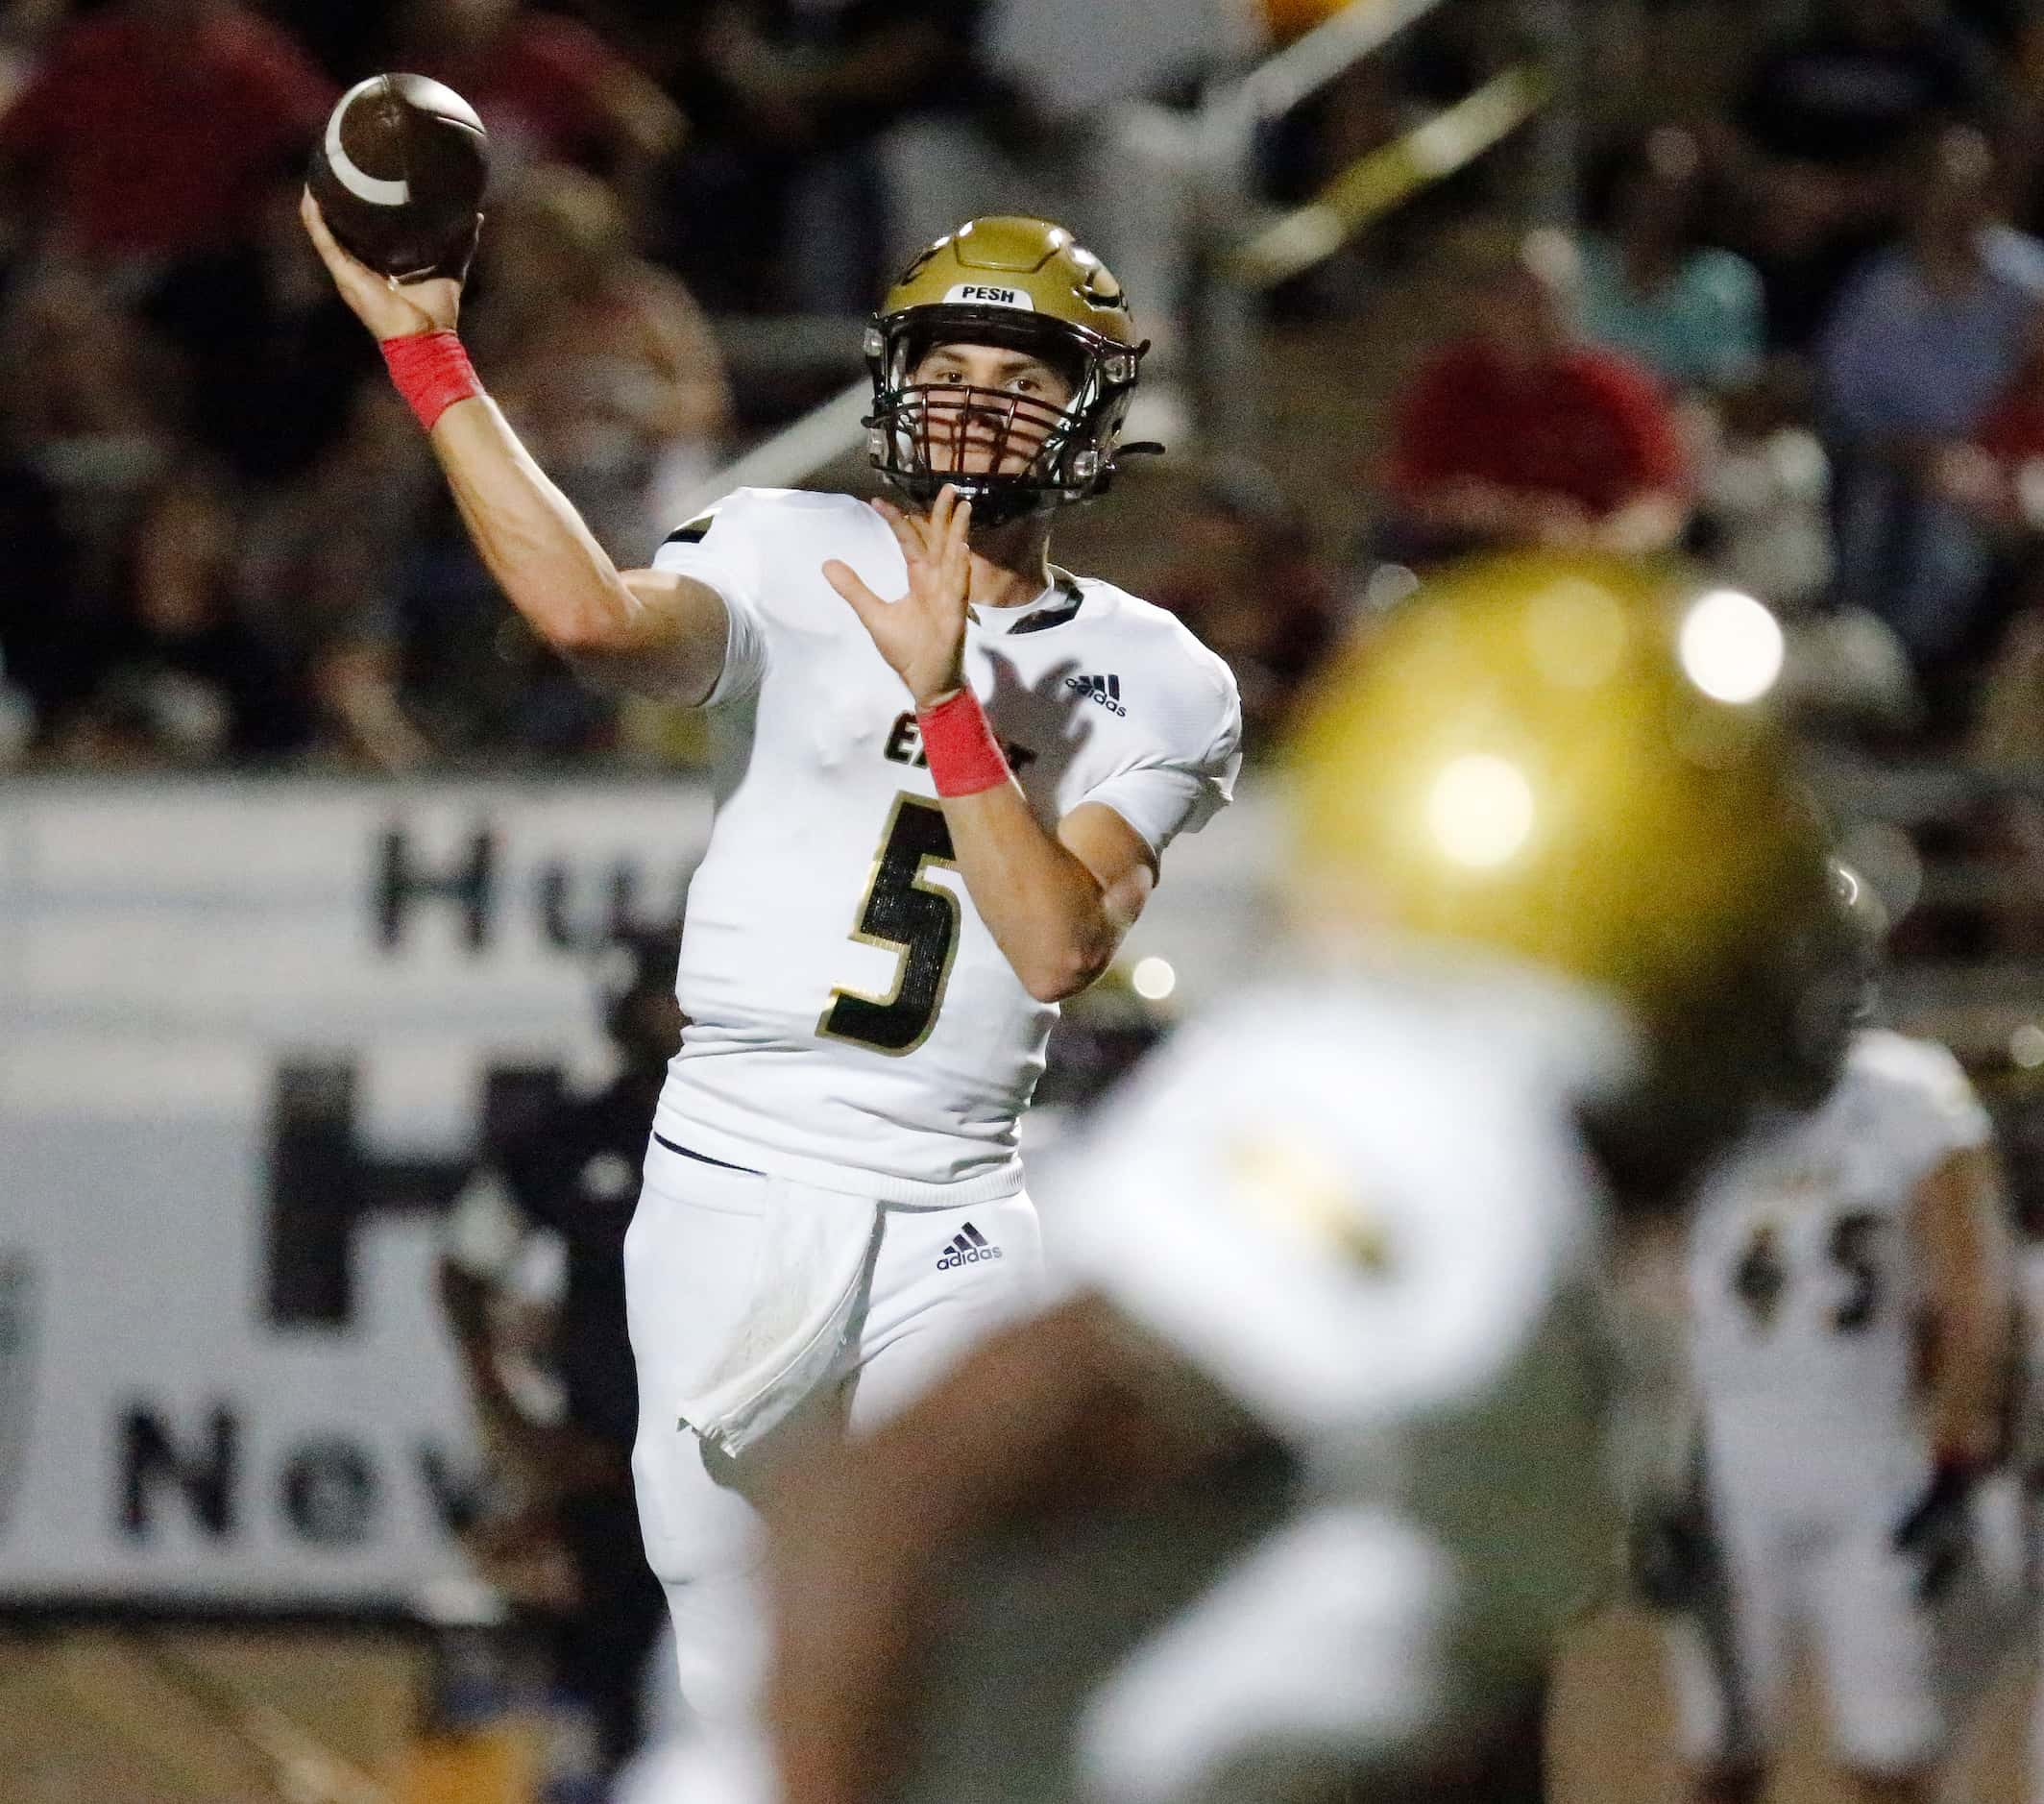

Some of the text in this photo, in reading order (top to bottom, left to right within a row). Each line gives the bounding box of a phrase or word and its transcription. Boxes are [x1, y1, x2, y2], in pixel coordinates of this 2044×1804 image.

[961, 286, 1014, 304] PESH
[815, 790, 961, 1057] 5
[937, 1246, 1003, 1270] adidas
